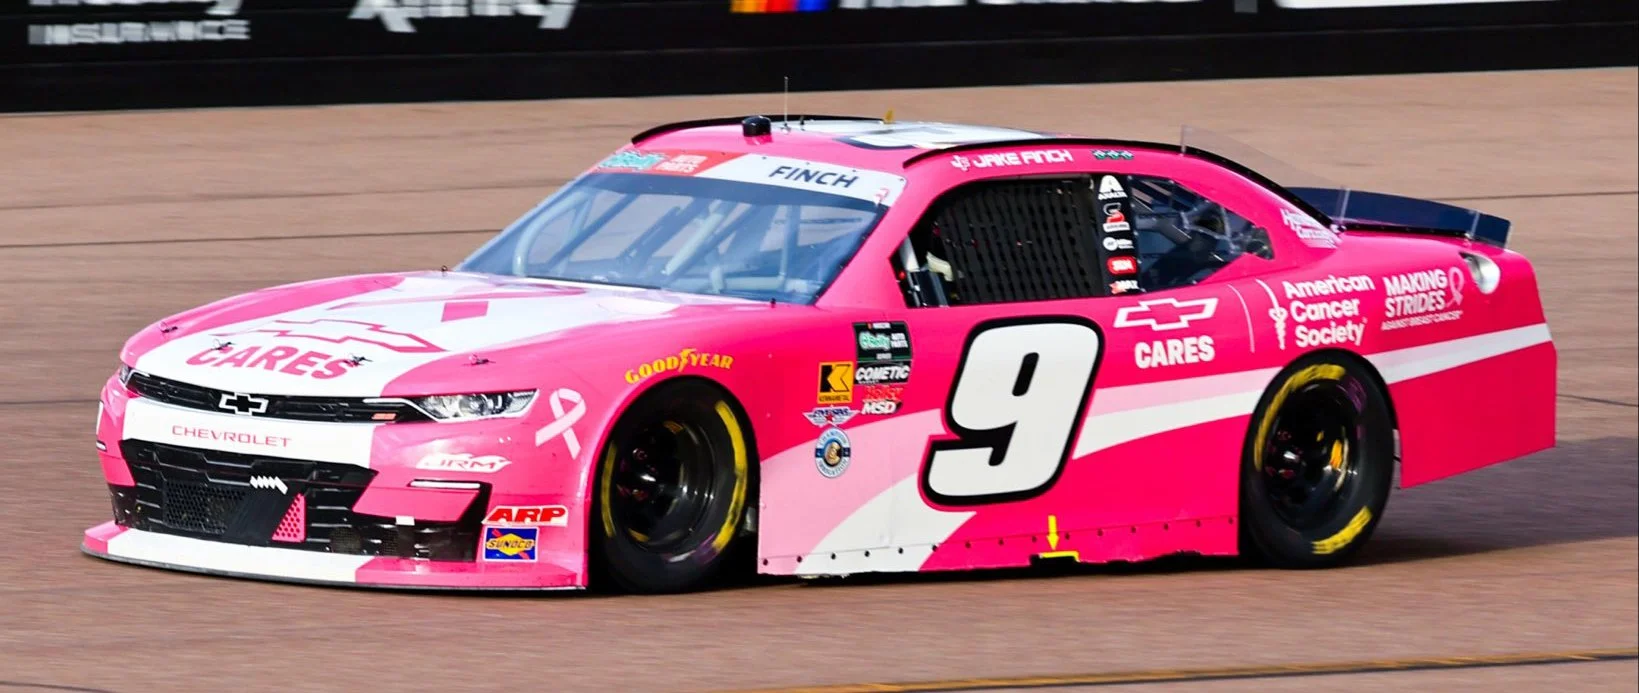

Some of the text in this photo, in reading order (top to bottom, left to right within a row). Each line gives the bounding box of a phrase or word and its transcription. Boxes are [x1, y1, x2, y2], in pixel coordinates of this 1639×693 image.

[972, 150, 1074, 168] JAKE FINCH
[768, 166, 859, 188] FINCH
[1282, 274, 1376, 299] American
[1382, 268, 1448, 296] MAKING
[1290, 298, 1360, 323] Cancer
[1385, 290, 1446, 318] STRIDES
[1295, 320, 1365, 348] Society
[186, 345, 354, 379] CARES
[1134, 335, 1215, 368] CARES
[624, 348, 734, 384] GOODYEAR
[855, 365, 910, 381] COMETIC
[862, 401, 898, 415] MSD
[921, 315, 1105, 507] 9
[172, 425, 292, 448] CHEVROLET
[488, 507, 567, 523] ARP
[488, 540, 533, 549] SUNOCO
